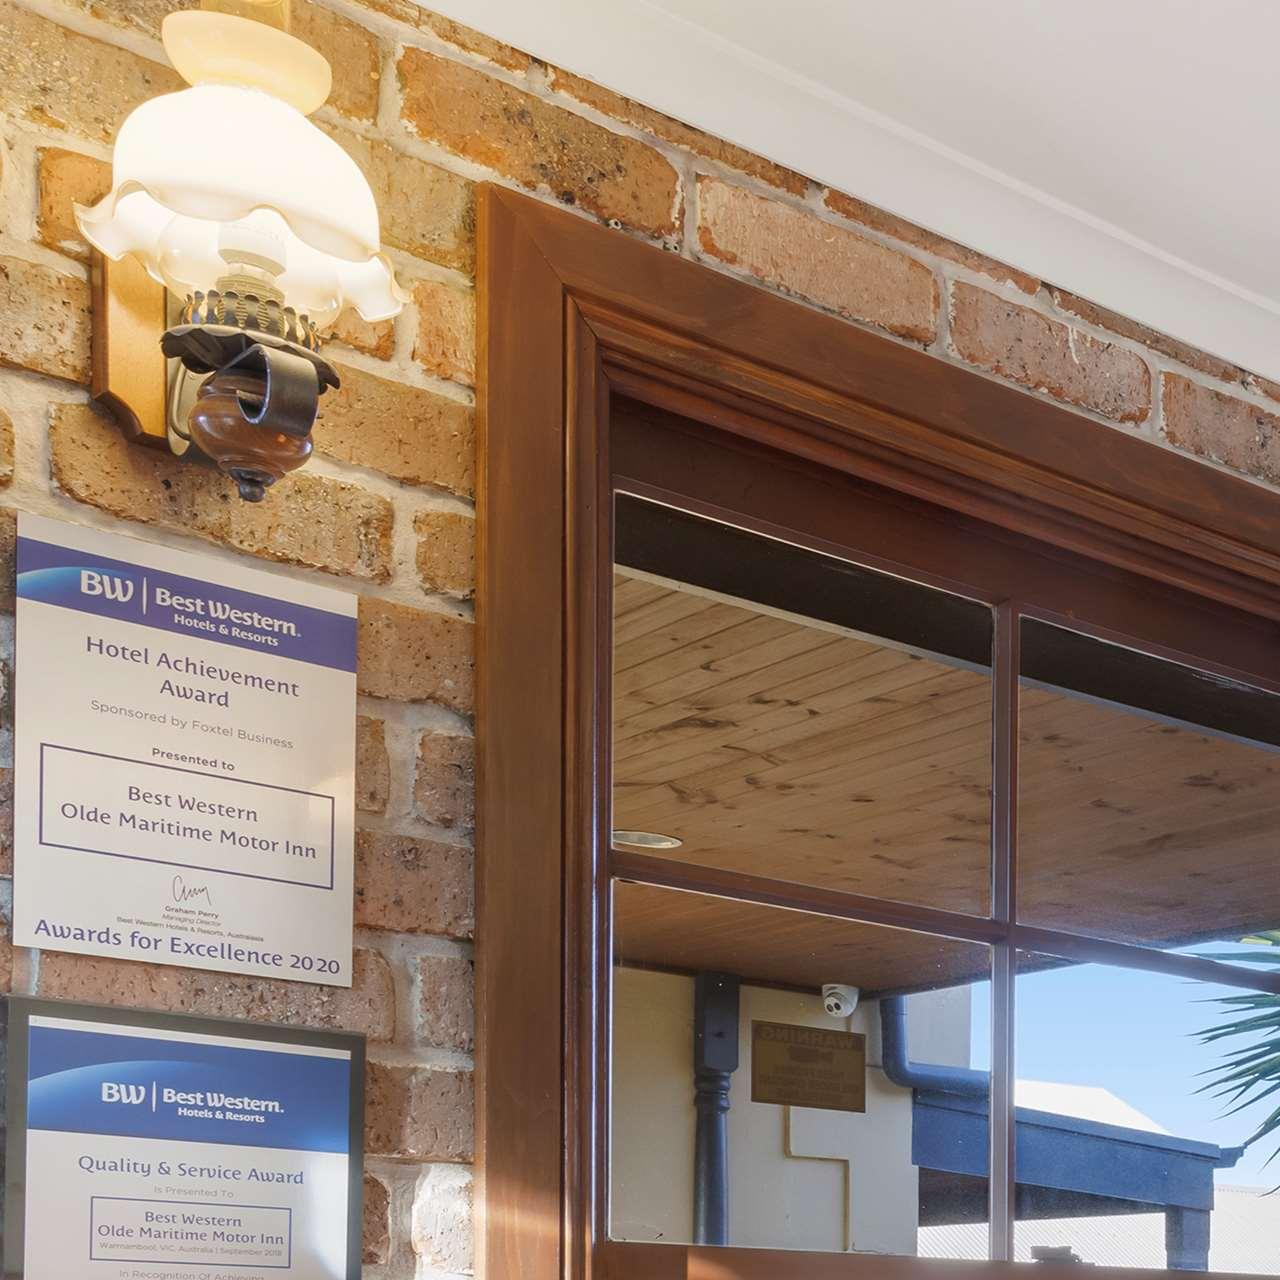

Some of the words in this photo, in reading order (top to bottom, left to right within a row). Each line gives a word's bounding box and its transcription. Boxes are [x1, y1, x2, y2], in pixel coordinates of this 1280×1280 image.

[80, 569, 134, 603] BW
[155, 587, 205, 614] Best
[174, 613, 217, 632] Hotels
[218, 624, 229, 635] &
[232, 627, 279, 647] Resorts
[87, 636, 149, 664] Hotel
[156, 652, 300, 697] Achievement
[159, 679, 229, 708] Award
[90, 699, 167, 724] Sponsored
[171, 716, 188, 730] by
[192, 720, 233, 737] Foxtel
[238, 729, 294, 749] Business
[152, 747, 217, 768] Presented
[222, 760, 236, 772] to
[128, 785, 172, 807] Best
[177, 794, 259, 822] Western
[61, 802, 111, 825] Olde
[118, 812, 214, 841] Maritime
[220, 829, 279, 852] Motor
[285, 840, 317, 859] Inn
[162, 913, 195, 925] Managing
[165, 905, 197, 916] Graham
[198, 910, 220, 920] Perry
[34, 919, 122, 946] Awards
[130, 930, 163, 951] for
[170, 936, 284, 967] Excellence
[289, 954, 340, 975] 2020
[101, 1082, 146, 1105] BW
[163, 1088, 205, 1106] Best
[177, 1107, 213, 1119] Hotels
[214, 1111, 224, 1120] &
[225, 1112, 265, 1124] Resorts
[78, 1155, 151, 1178] Quality
[158, 1161, 171, 1176] &
[177, 1162, 242, 1181] Service
[247, 1167, 304, 1185] Award
[166, 1186, 218, 1198] Presented
[221, 1189, 234, 1199] To
[145, 1211, 177, 1224] Best
[181, 1213, 242, 1227] Western
[98, 1224, 134, 1238] Olde
[139, 1227, 208, 1242] Maritime
[212, 1230, 257, 1244] Motor
[260, 1233, 285, 1245] Inn
[119, 1270, 129, 1278] In
[198, 1272, 211, 1280] Of
